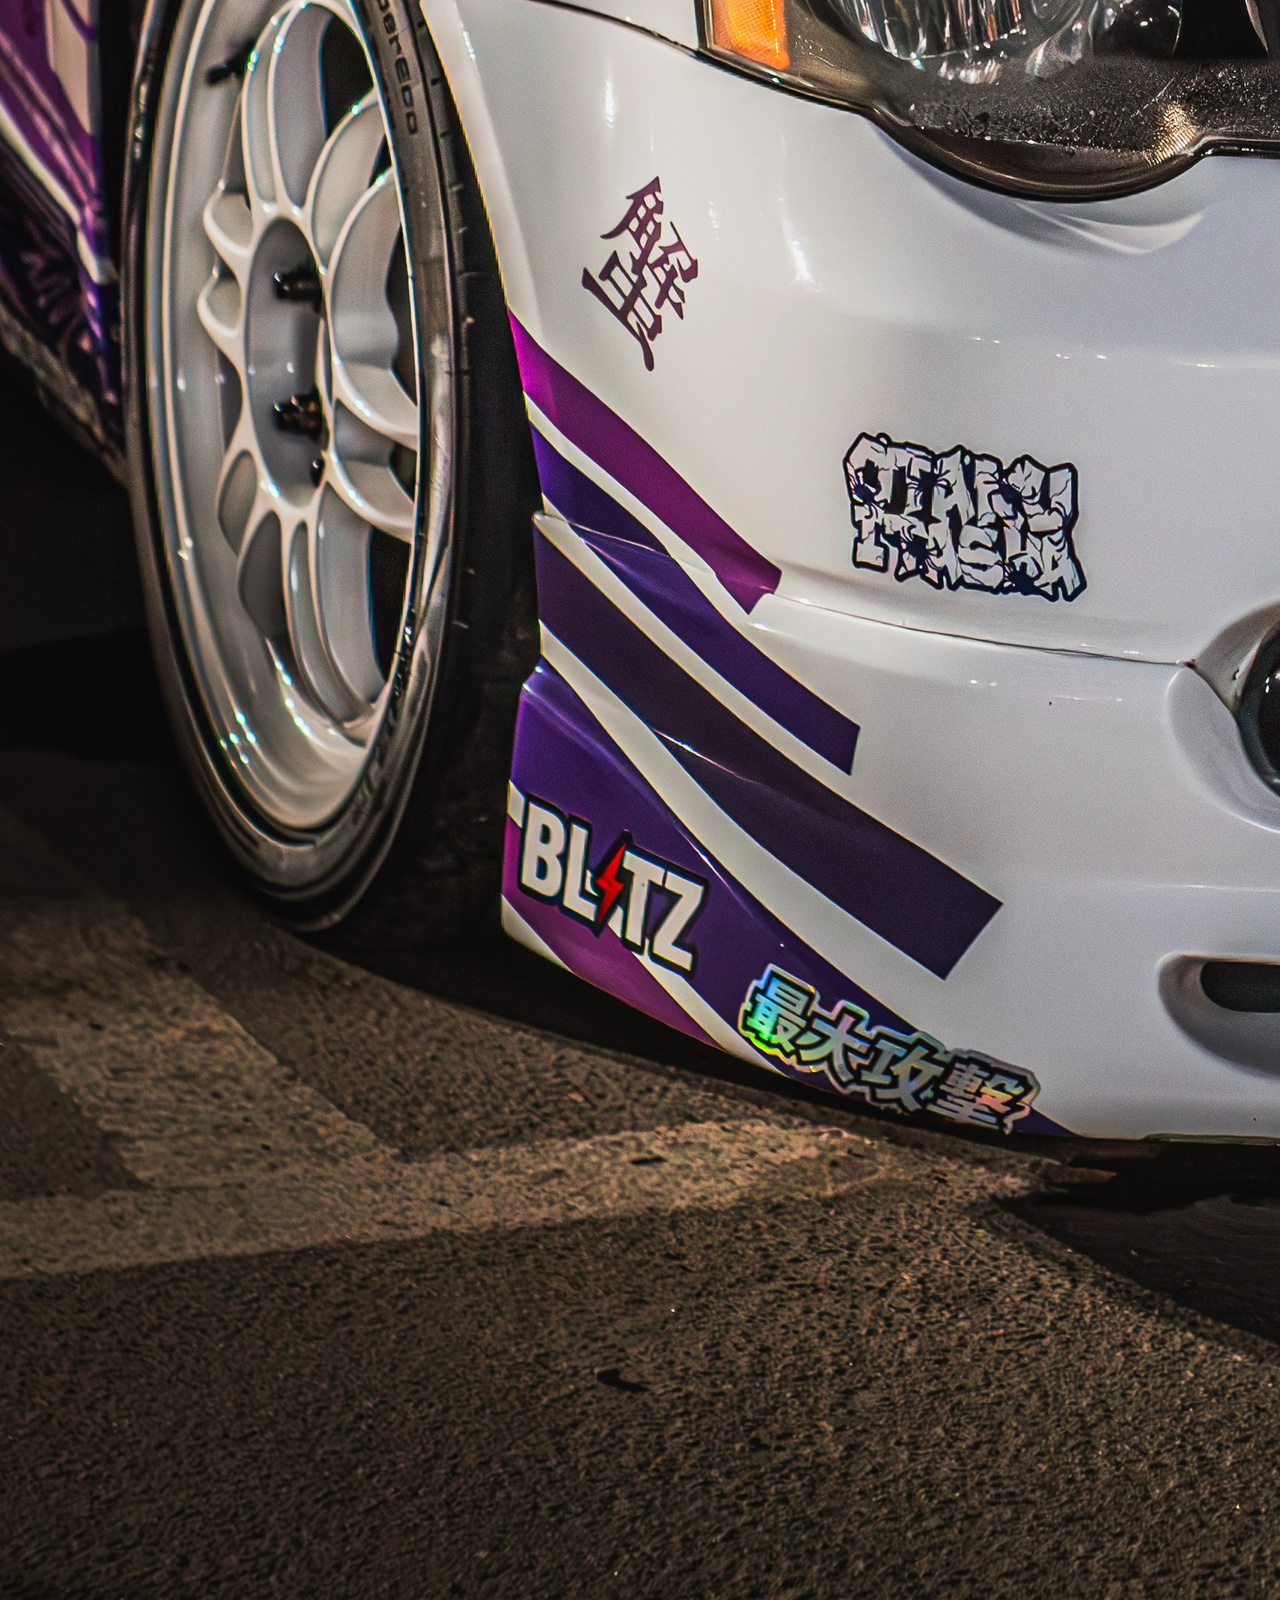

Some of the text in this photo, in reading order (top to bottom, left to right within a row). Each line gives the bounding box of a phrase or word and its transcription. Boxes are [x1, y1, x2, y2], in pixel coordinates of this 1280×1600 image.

[582, 175, 701, 372] 蟹
[521, 800, 705, 973] BLITZ
[745, 967, 1031, 1135] 最大攻撃
